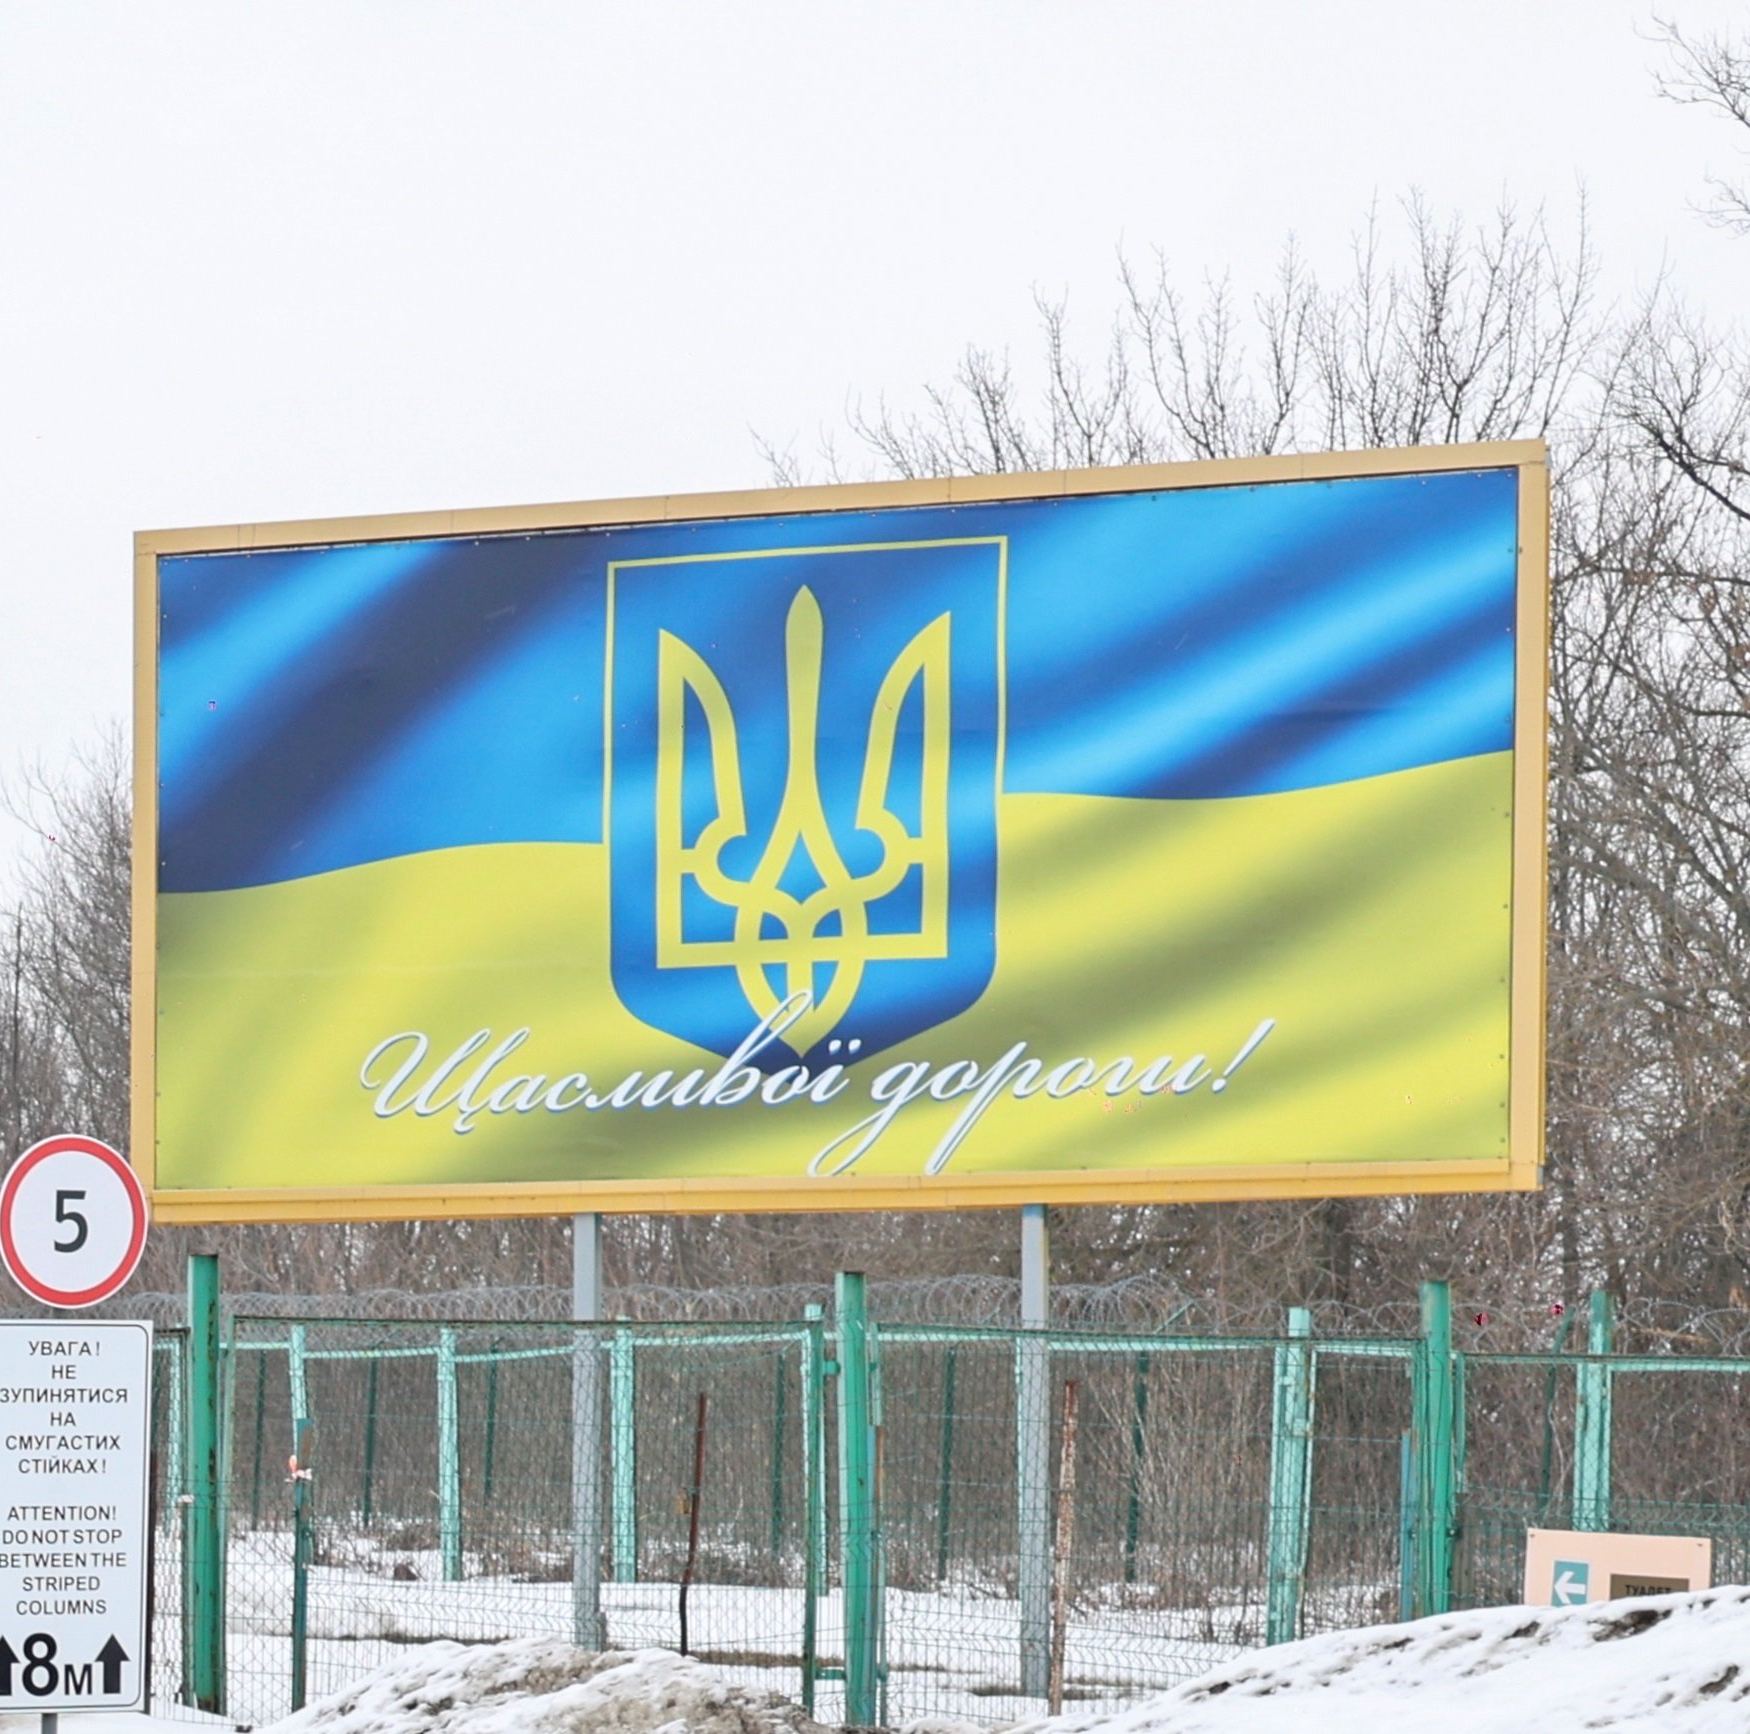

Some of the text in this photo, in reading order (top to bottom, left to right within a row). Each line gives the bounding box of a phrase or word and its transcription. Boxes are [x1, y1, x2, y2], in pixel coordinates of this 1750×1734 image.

[360, 989, 1276, 1177] Щасливої дороги!
[53, 1189, 89, 1254] 5
[51, 1364, 76, 1380] НЕ
[0, 1387, 128, 1404] ЗУПИНЯТИСЯ
[50, 1411, 77, 1427] НА
[5, 1434, 121, 1451] СМУГАСТИХ
[7, 1505, 116, 1521] ATTENTION!
[2, 1528, 123, 1545] DO NOT STOP
[90, 1552, 126, 1568] THE
[22, 1575, 101, 1592] STRIPED
[15, 1599, 107, 1616] COLUMNS
